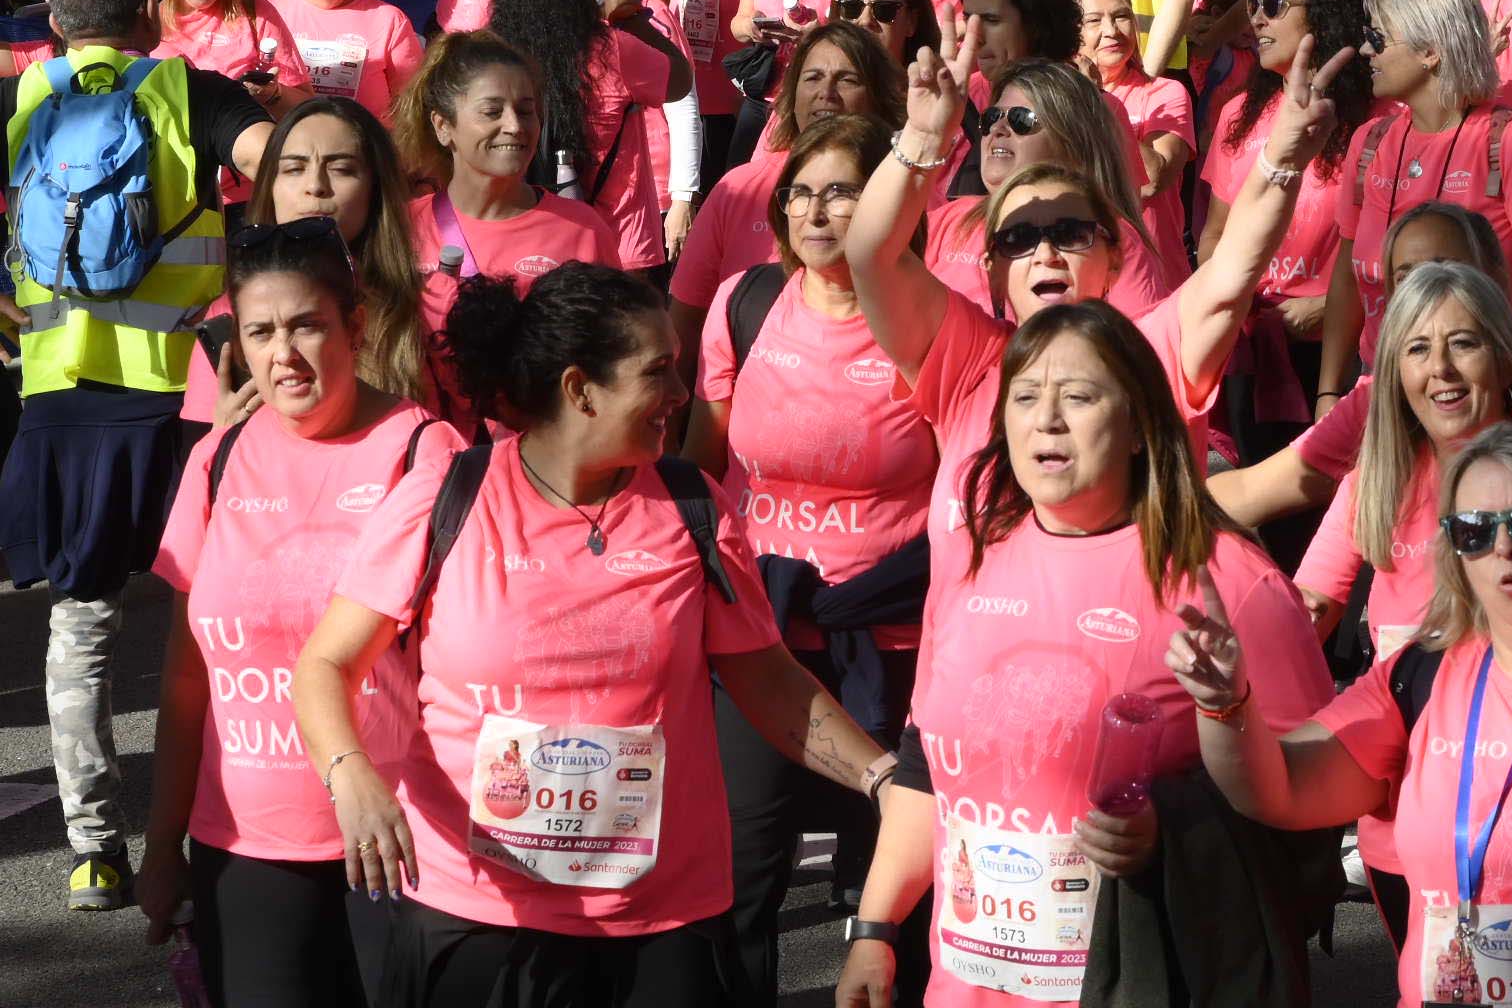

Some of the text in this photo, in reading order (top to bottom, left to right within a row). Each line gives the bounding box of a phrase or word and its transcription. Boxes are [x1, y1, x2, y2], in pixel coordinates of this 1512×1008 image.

[1268, 254, 1320, 280] RSAL
[227, 496, 290, 513] OYSHO
[737, 489, 865, 534] DORSAL
[967, 595, 1029, 617] OYSHO
[197, 616, 245, 652] TU
[1081, 615, 1136, 638] ASTURIANA
[465, 684, 524, 717] TU
[224, 719, 305, 756] SUM
[1430, 736, 1507, 759] OYHO
[537, 750, 605, 767] ASTURIANA
[617, 747, 652, 757] SUMA
[924, 732, 963, 777] TU
[535, 787, 598, 812] 016
[545, 817, 583, 833] 1572
[489, 829, 640, 851] CARRERA DE LA MUJER 2023
[583, 861, 641, 876] Santander
[979, 854, 1038, 877] ASTURIANA
[1049, 855, 1086, 867] SUMA
[981, 894, 1037, 923] 016
[992, 925, 1026, 944] 1573
[952, 935, 1087, 964] CARRERA DE LA MUJER 2023
[952, 956, 996, 978] OYSHO
[1034, 974, 1084, 988] Santand
